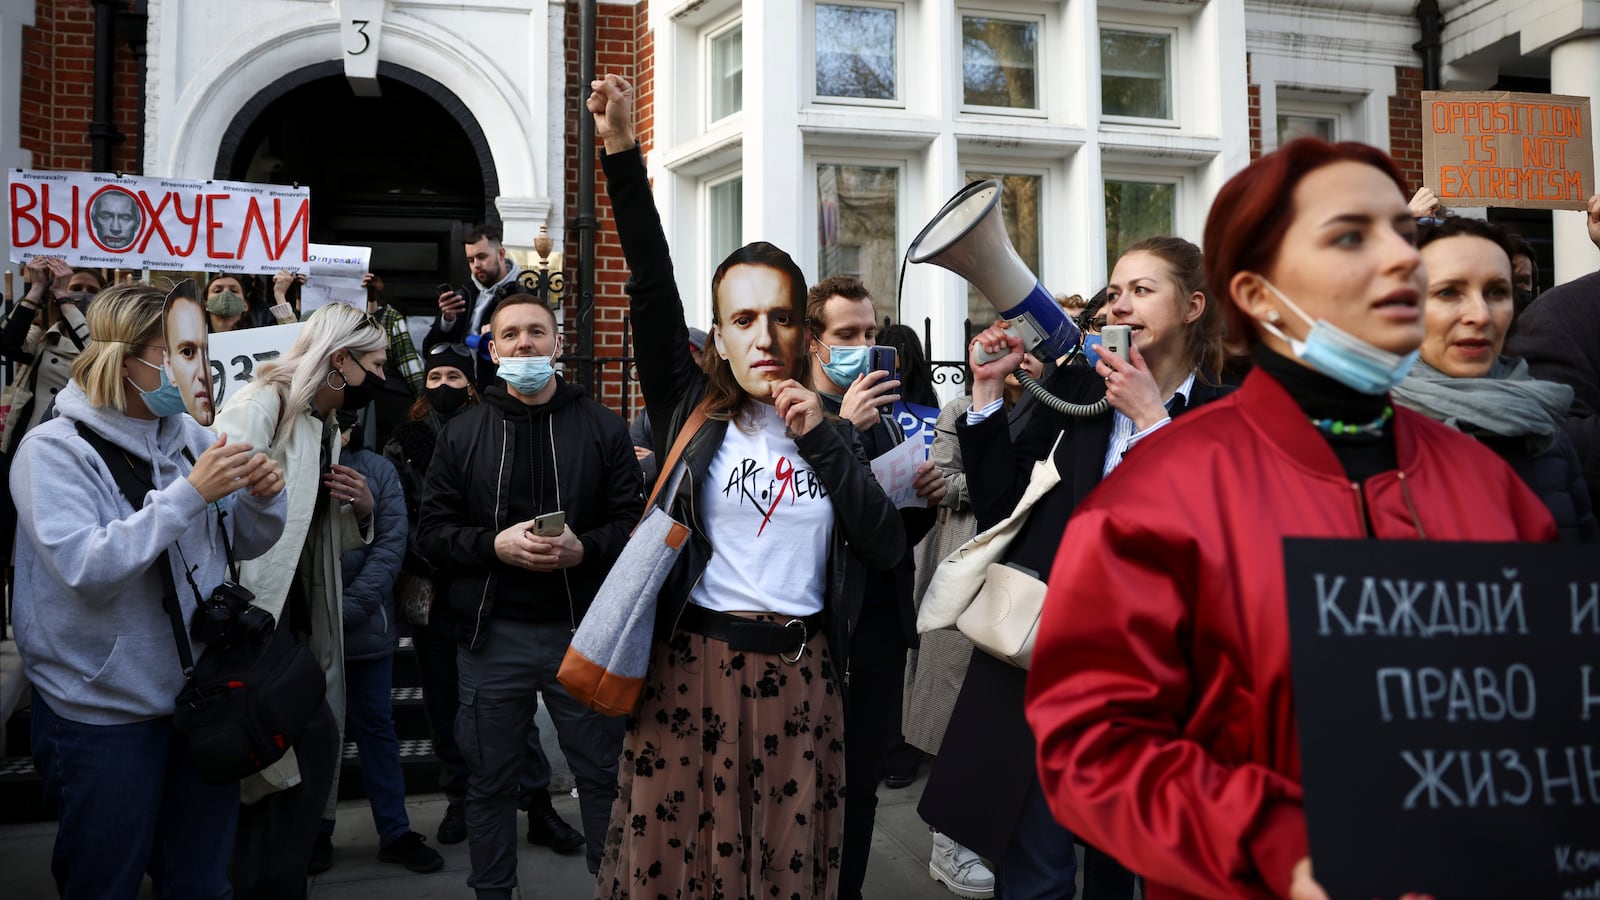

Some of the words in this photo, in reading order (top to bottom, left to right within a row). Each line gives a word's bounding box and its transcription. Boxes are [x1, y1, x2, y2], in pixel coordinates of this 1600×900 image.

[347, 19, 370, 55] 3
[1432, 101, 1583, 138] OPPOSITION
[1463, 135, 1497, 165] IS
[1522, 136, 1569, 169] NOT
[23, 173, 68, 181] #freenavalny
[93, 176, 138, 185] #freenavalny
[160, 181, 203, 190] #freenavalny
[223, 185, 264, 194] #freenavalny
[1440, 165, 1583, 200] EXTREMISM
[80, 255, 124, 264] #freenavalny
[142, 260, 184, 268] #freenavalny
[204, 262, 245, 271] #freenavalny
[722, 458, 771, 523] ART
[761, 479, 776, 507] of
[1314, 567, 1530, 637] КАЖДЫЙ
[1376, 663, 1537, 721] ПРАВО
